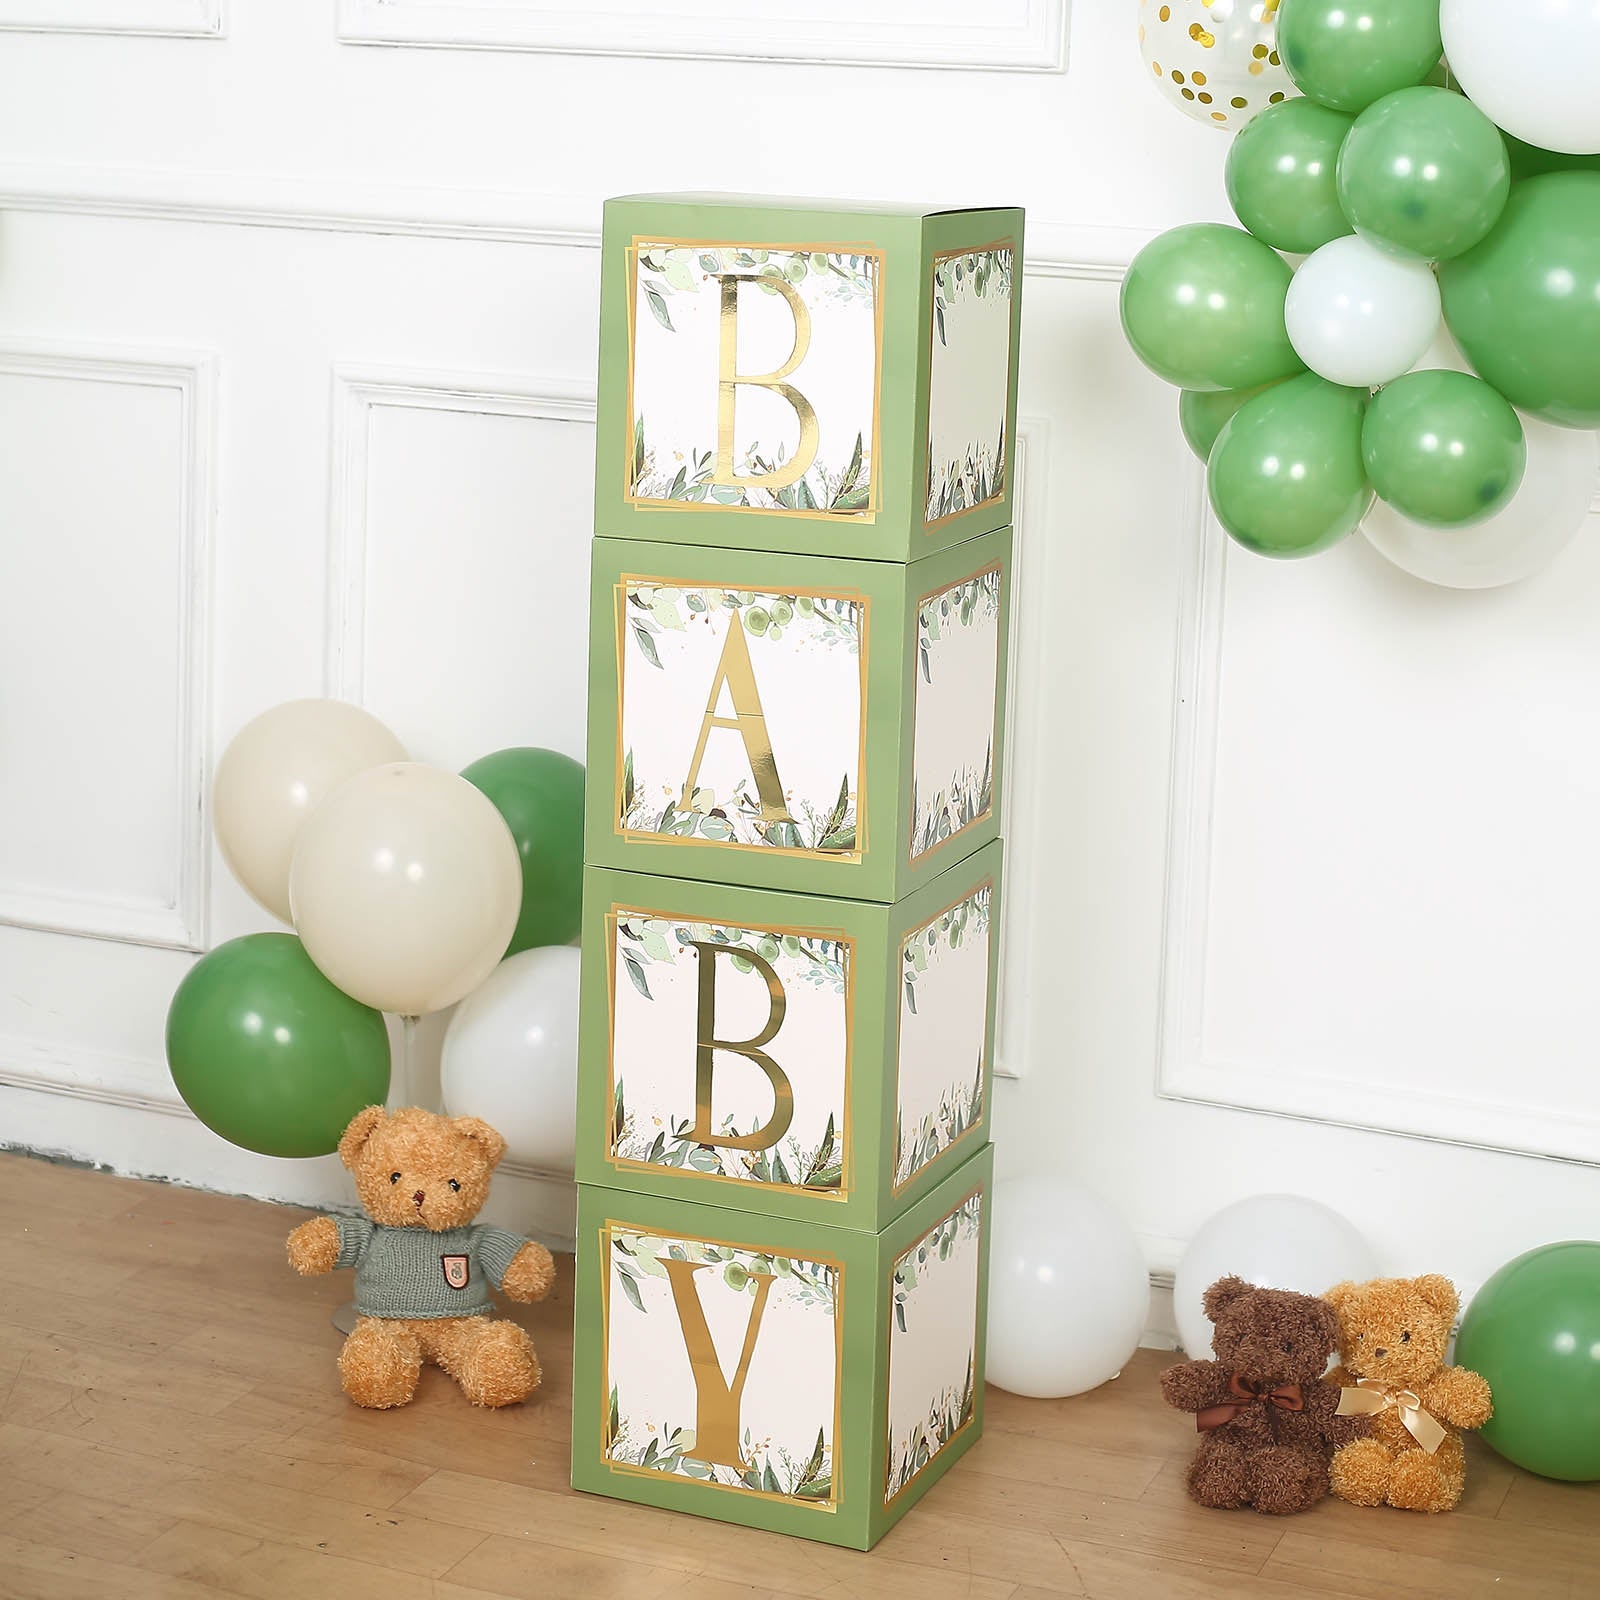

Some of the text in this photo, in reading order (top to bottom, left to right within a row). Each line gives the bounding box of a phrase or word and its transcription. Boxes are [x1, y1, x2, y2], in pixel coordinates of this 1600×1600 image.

[697, 274, 820, 489] B
[672, 607, 800, 825] A
[671, 941, 794, 1151] B
[654, 1257, 778, 1472] Y
